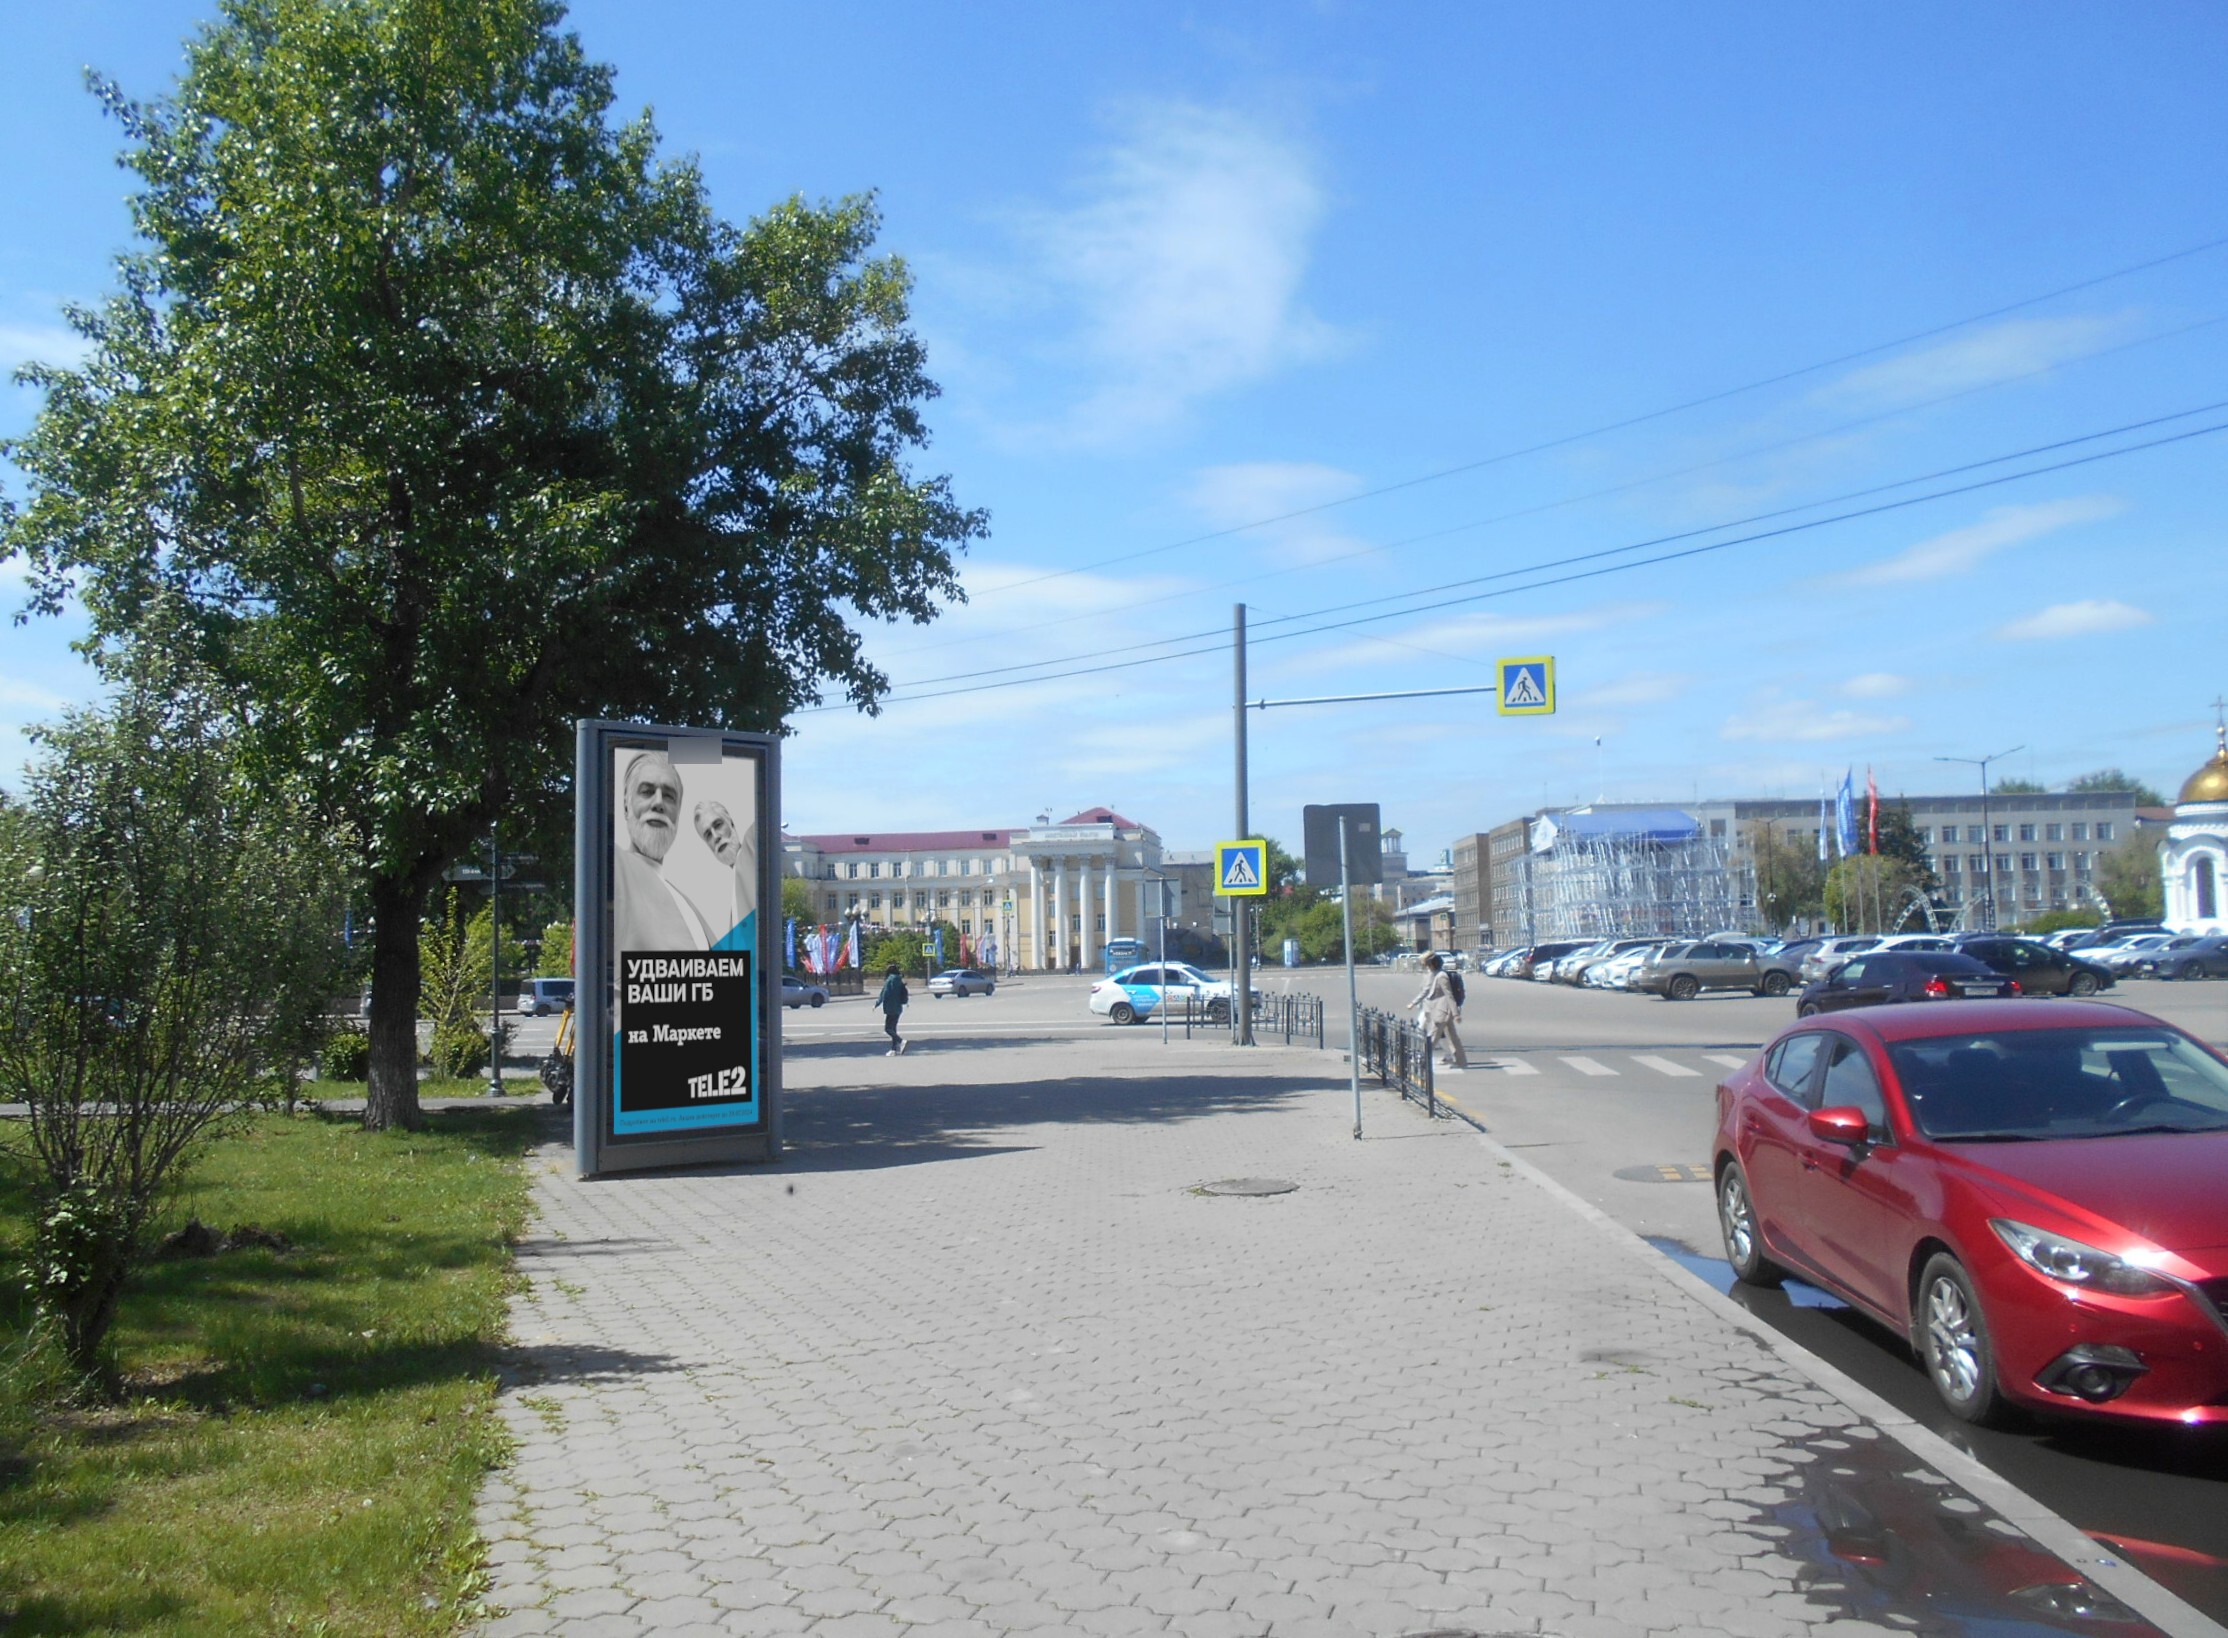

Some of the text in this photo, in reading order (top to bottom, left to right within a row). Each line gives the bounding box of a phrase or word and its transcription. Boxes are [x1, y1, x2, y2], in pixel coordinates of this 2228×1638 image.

[627, 958, 744, 983] УДВАИВАЕМ
[627, 982, 714, 1004] ВАШИ ГБ
[627, 1024, 722, 1046] на Маркете
[687, 1065, 747, 1099] TELE2
